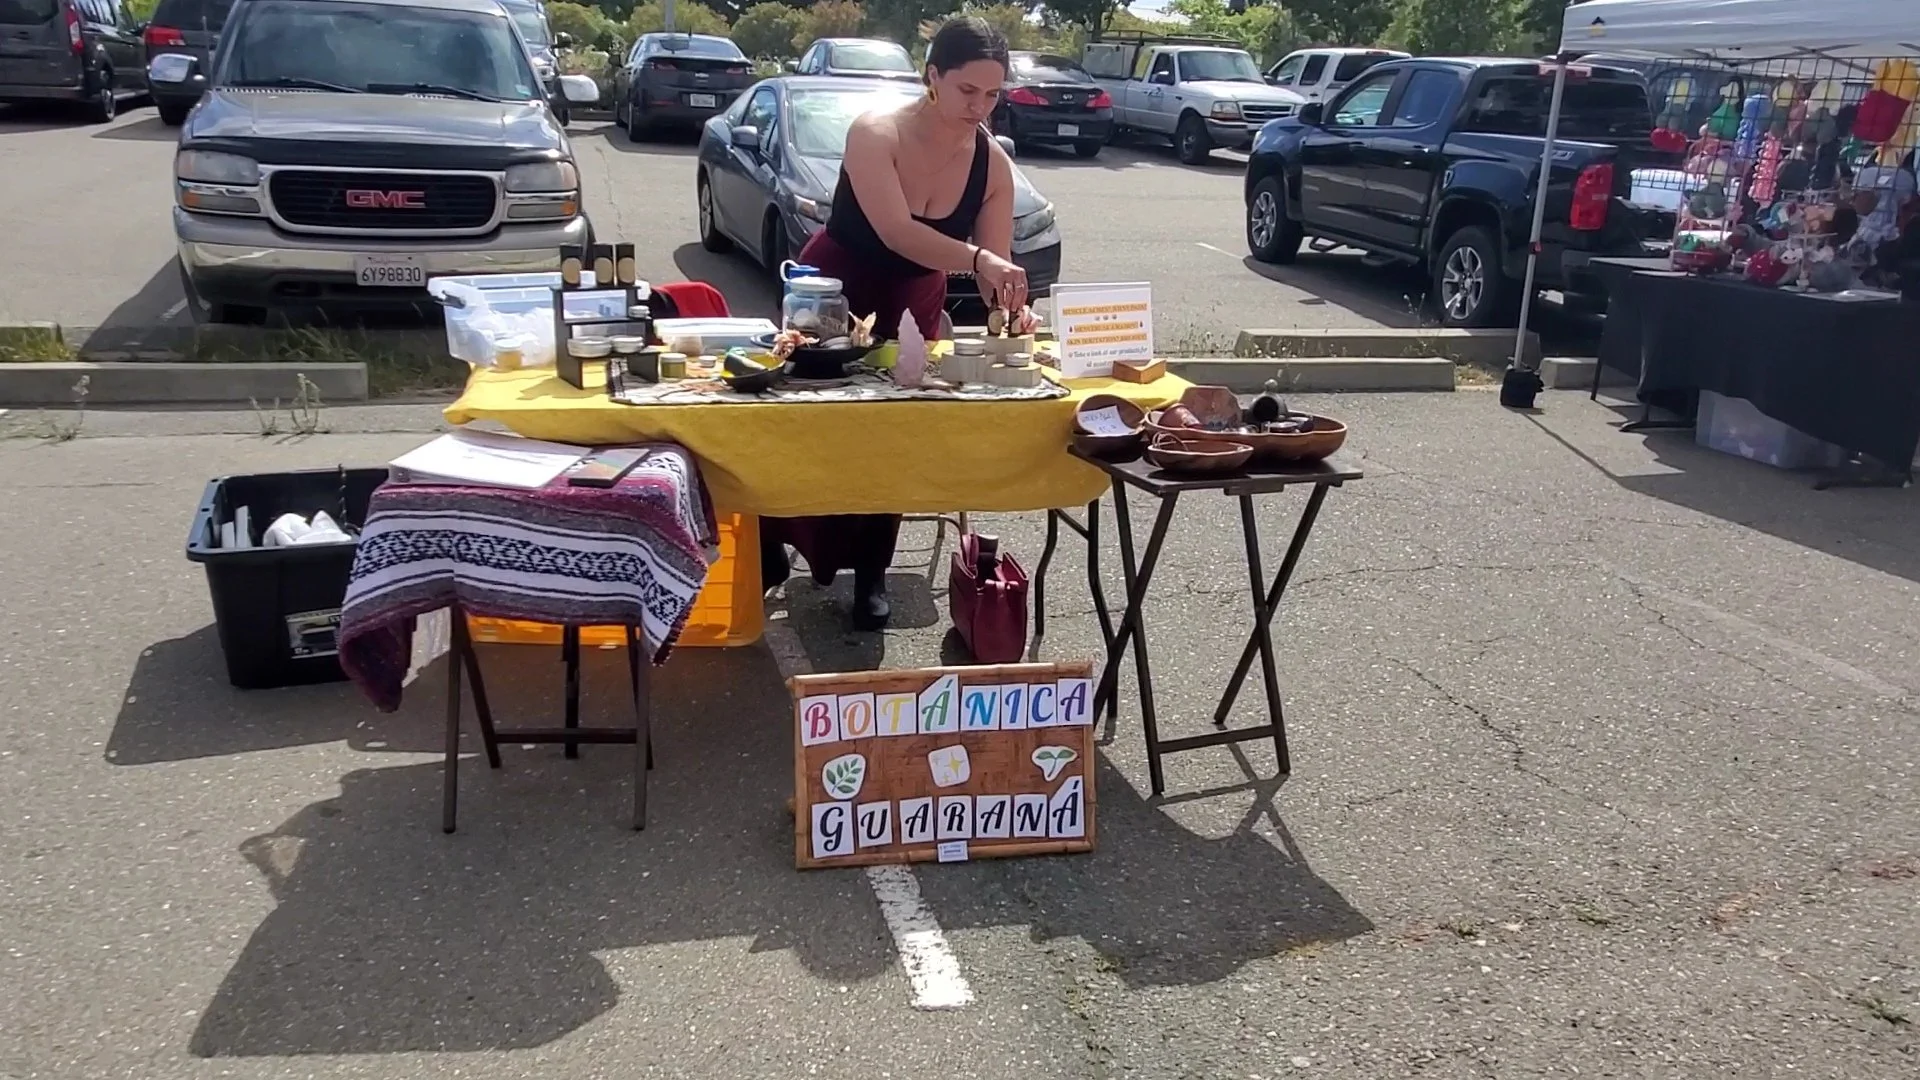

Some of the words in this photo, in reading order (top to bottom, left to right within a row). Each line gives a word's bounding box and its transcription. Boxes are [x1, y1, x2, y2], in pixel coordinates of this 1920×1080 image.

[346, 190, 425, 208] GMC
[361, 266, 421, 282] 6Y98830
[804, 678, 1087, 739] BOTÁNICA
[820, 779, 1081, 852] GUARANÁ
